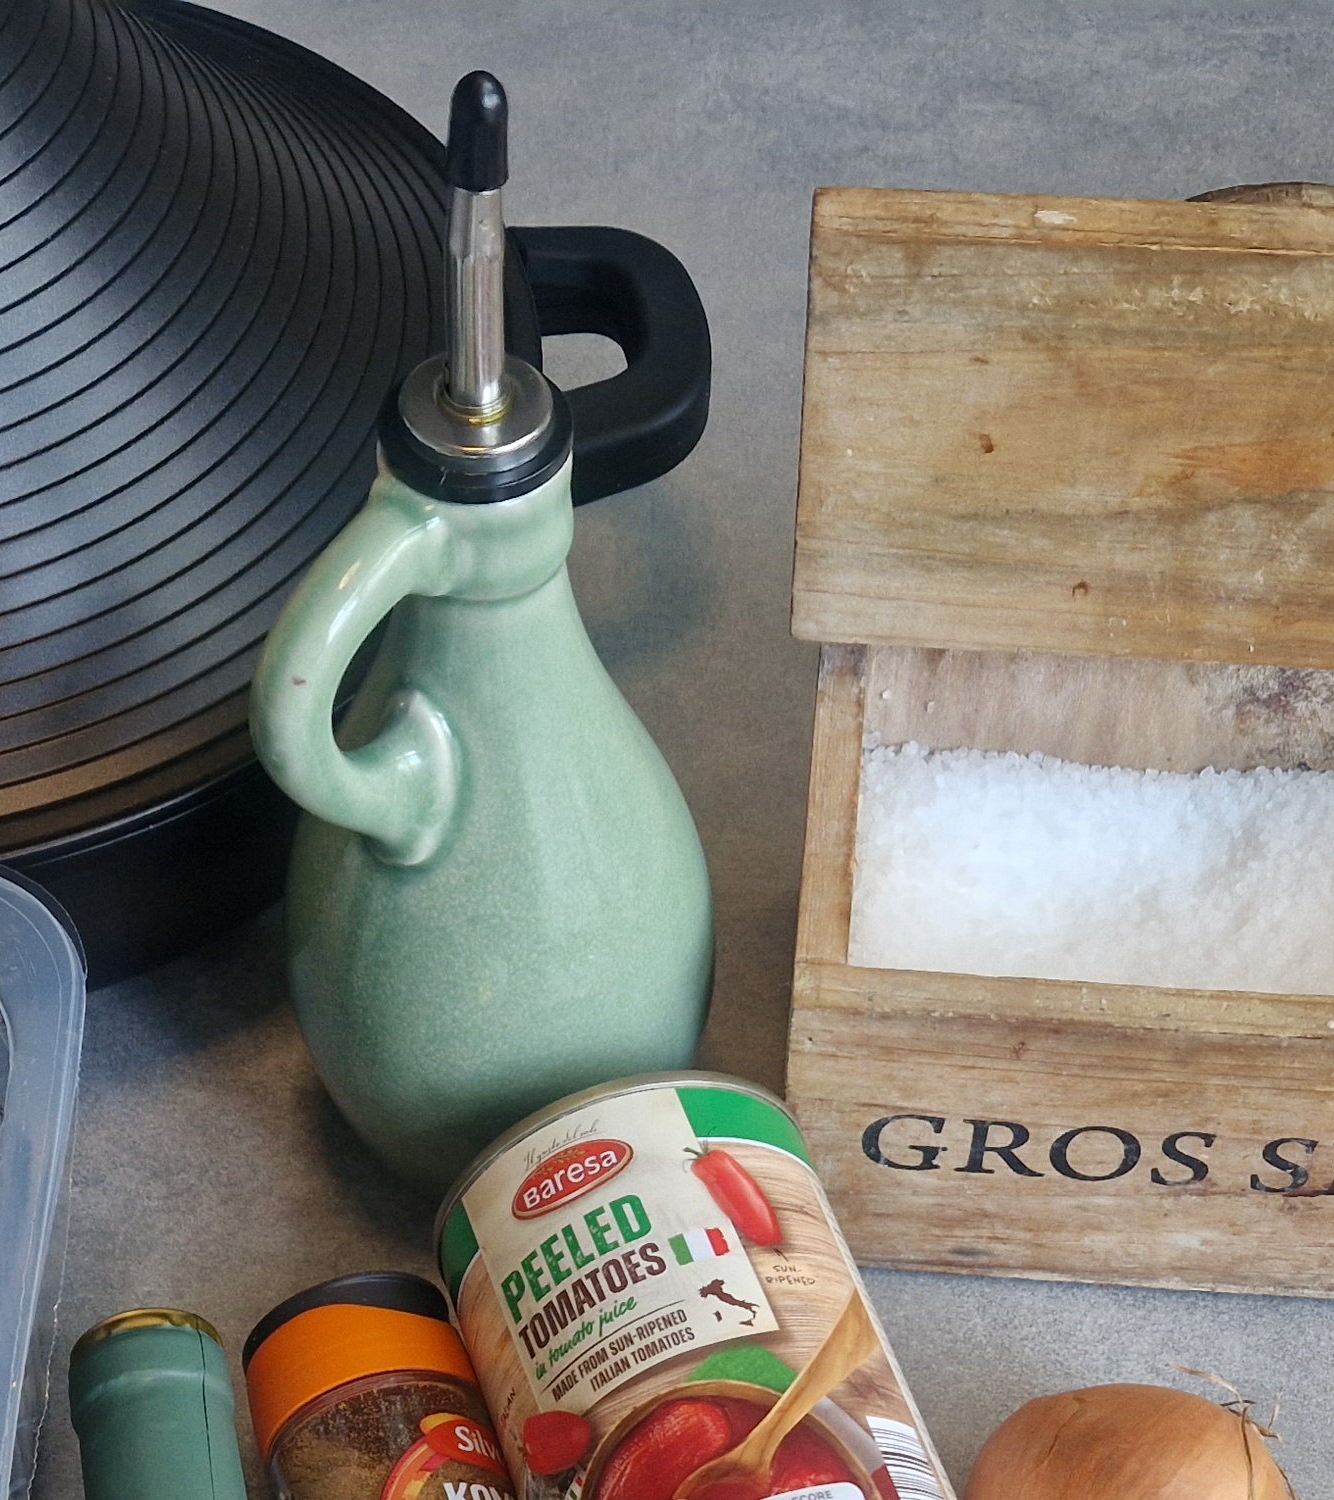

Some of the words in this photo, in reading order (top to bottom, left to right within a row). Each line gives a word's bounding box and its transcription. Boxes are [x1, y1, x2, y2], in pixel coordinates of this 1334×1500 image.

[522, 1149, 617, 1211] Baresa
[861, 1114, 1216, 1187] GROS
[501, 1195, 652, 1324] PEELED
[518, 1242, 666, 1359] TOMATOES
[535, 1362, 547, 1379] in
[548, 1320, 595, 1364] tomato
[598, 1297, 637, 1337] juice
[551, 1370, 579, 1402] MADE
[578, 1347, 608, 1380] FROM
[608, 1309, 688, 1356] SUN-RIPENED
[590, 1357, 631, 1392] ITALIAN
[631, 1327, 695, 1365] TOMATOES
